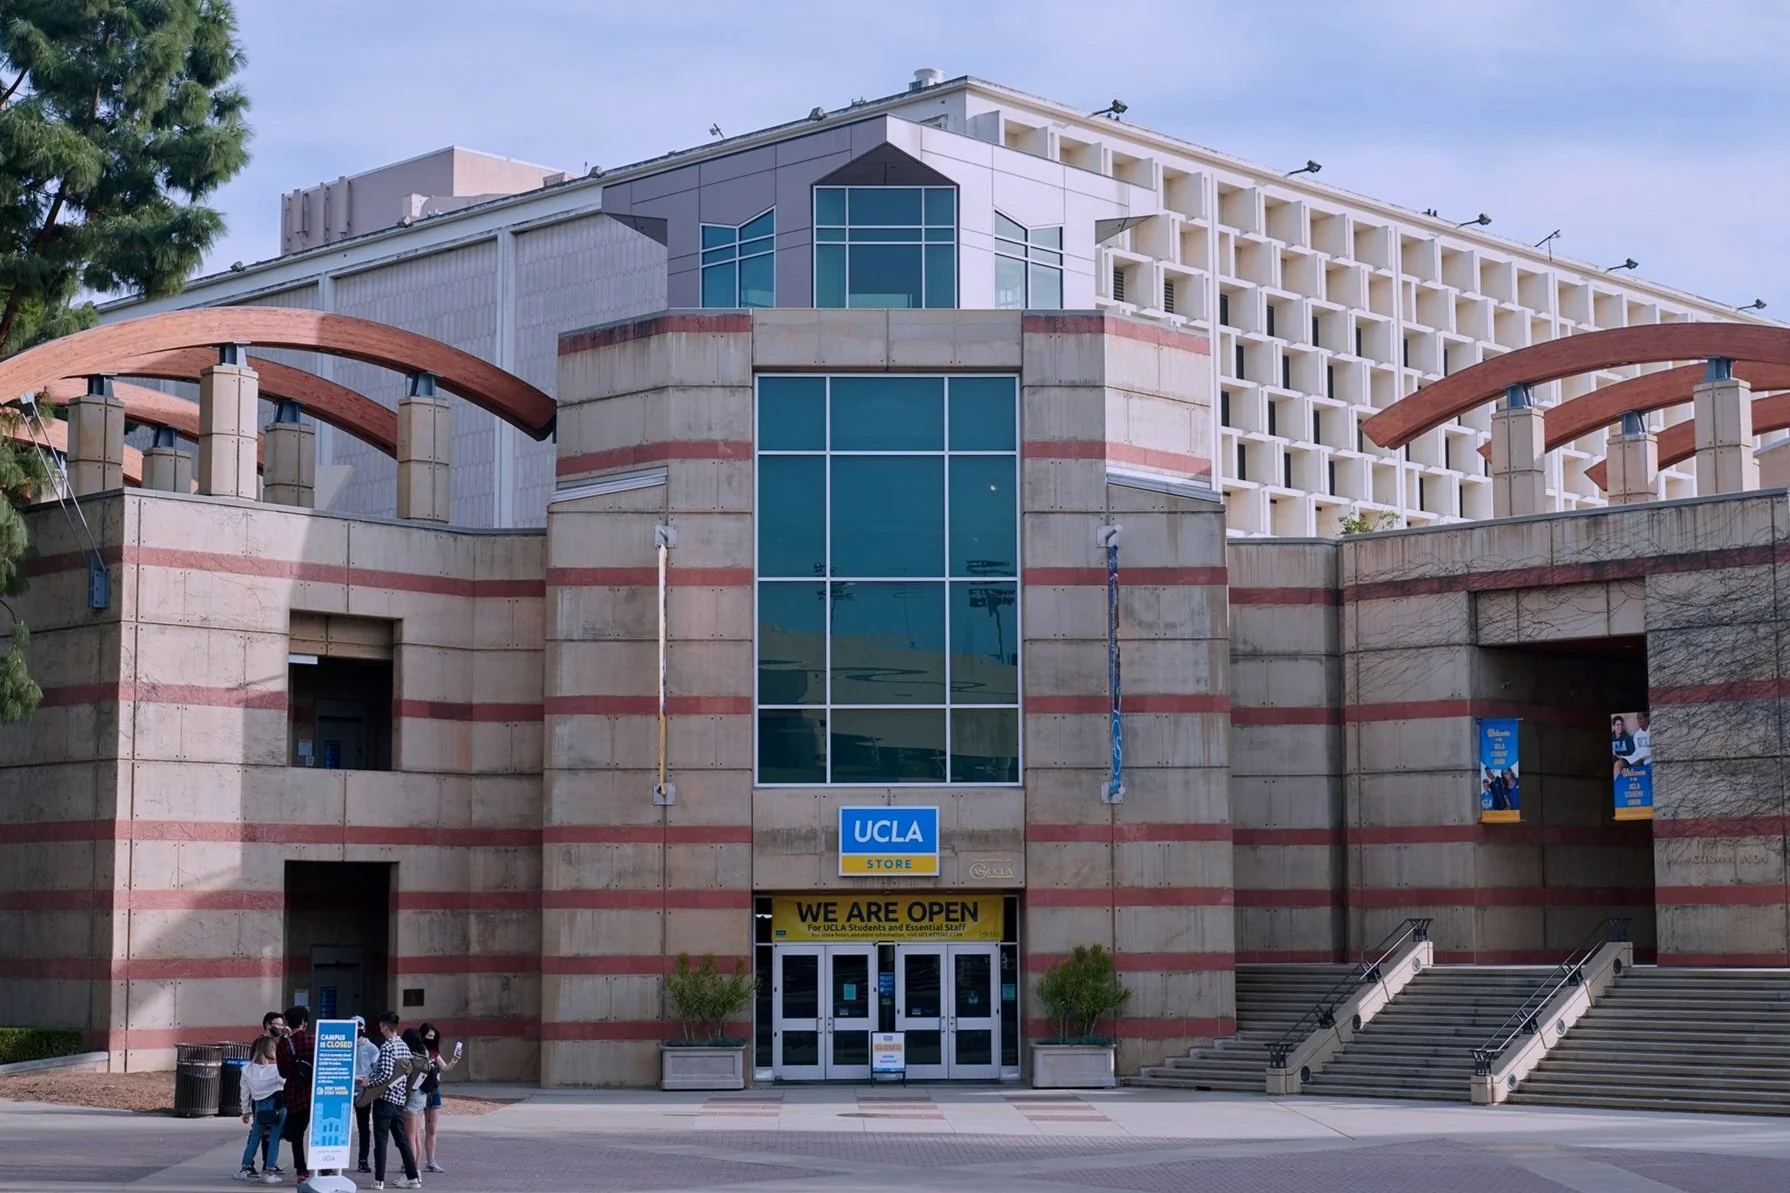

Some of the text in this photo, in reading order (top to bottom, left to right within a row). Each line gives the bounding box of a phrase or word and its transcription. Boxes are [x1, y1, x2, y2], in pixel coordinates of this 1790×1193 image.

[854, 819, 924, 843] UCLA
[866, 859, 912, 869] STORE
[796, 901, 978, 923] WE ARE OPEN
[807, 923, 967, 932] For UCLA Students and Essential Staff
